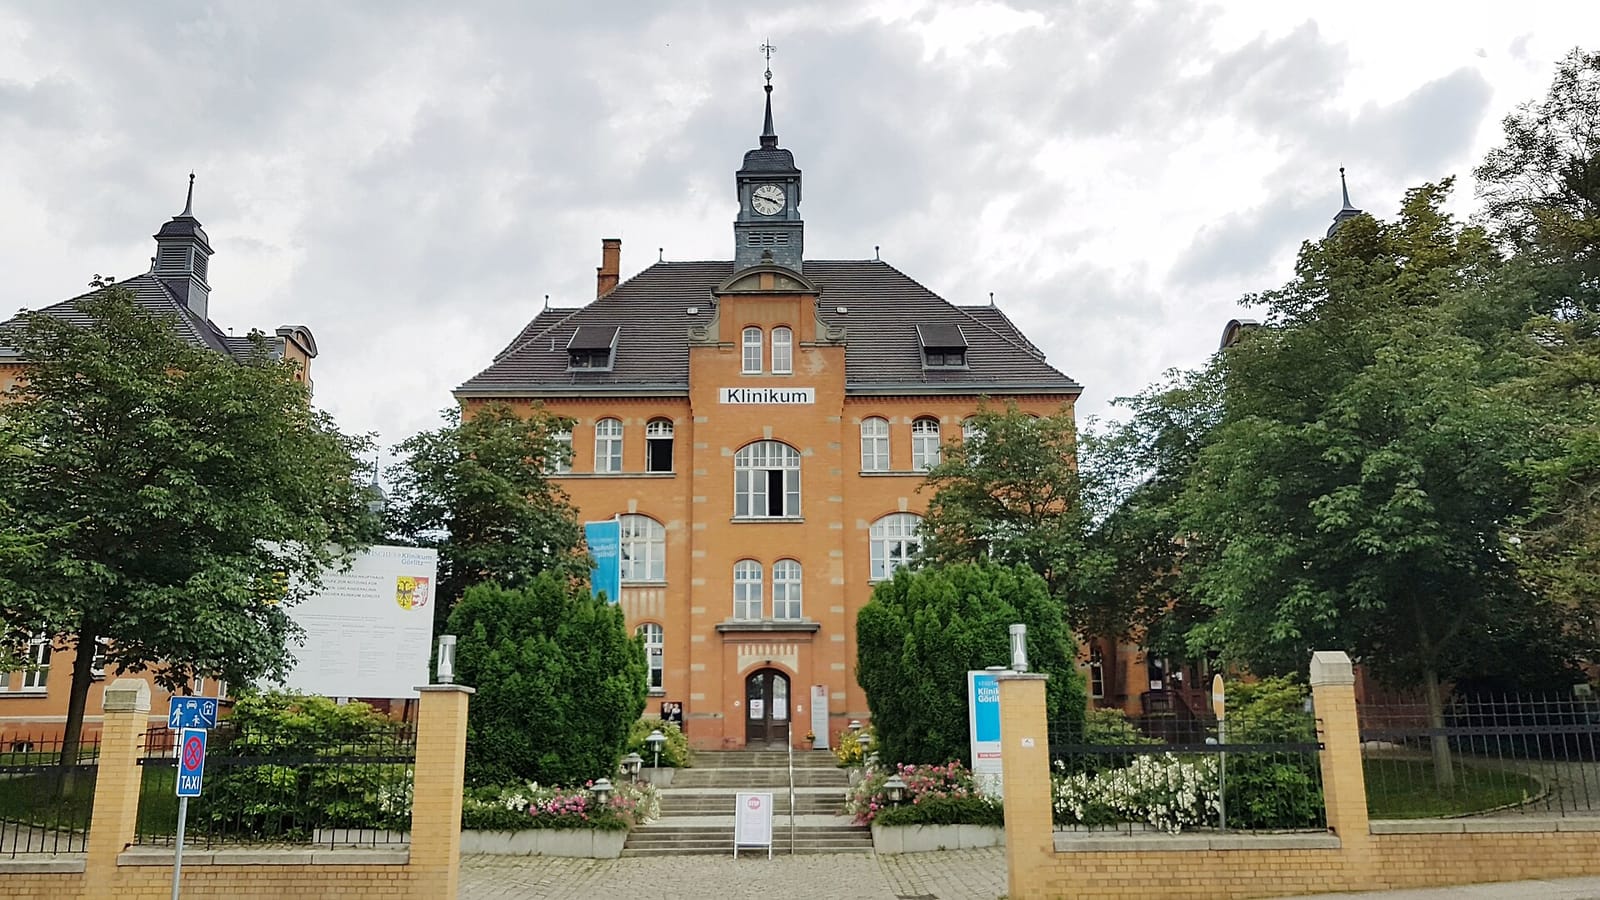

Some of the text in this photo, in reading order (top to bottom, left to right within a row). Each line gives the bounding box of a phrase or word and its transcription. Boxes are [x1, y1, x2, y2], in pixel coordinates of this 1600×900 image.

[727, 388, 807, 403] Klinikum
[978, 687, 1000, 695] Klinik
[978, 694, 1000, 703] Görlit
[181, 775, 200, 790] TAXI
